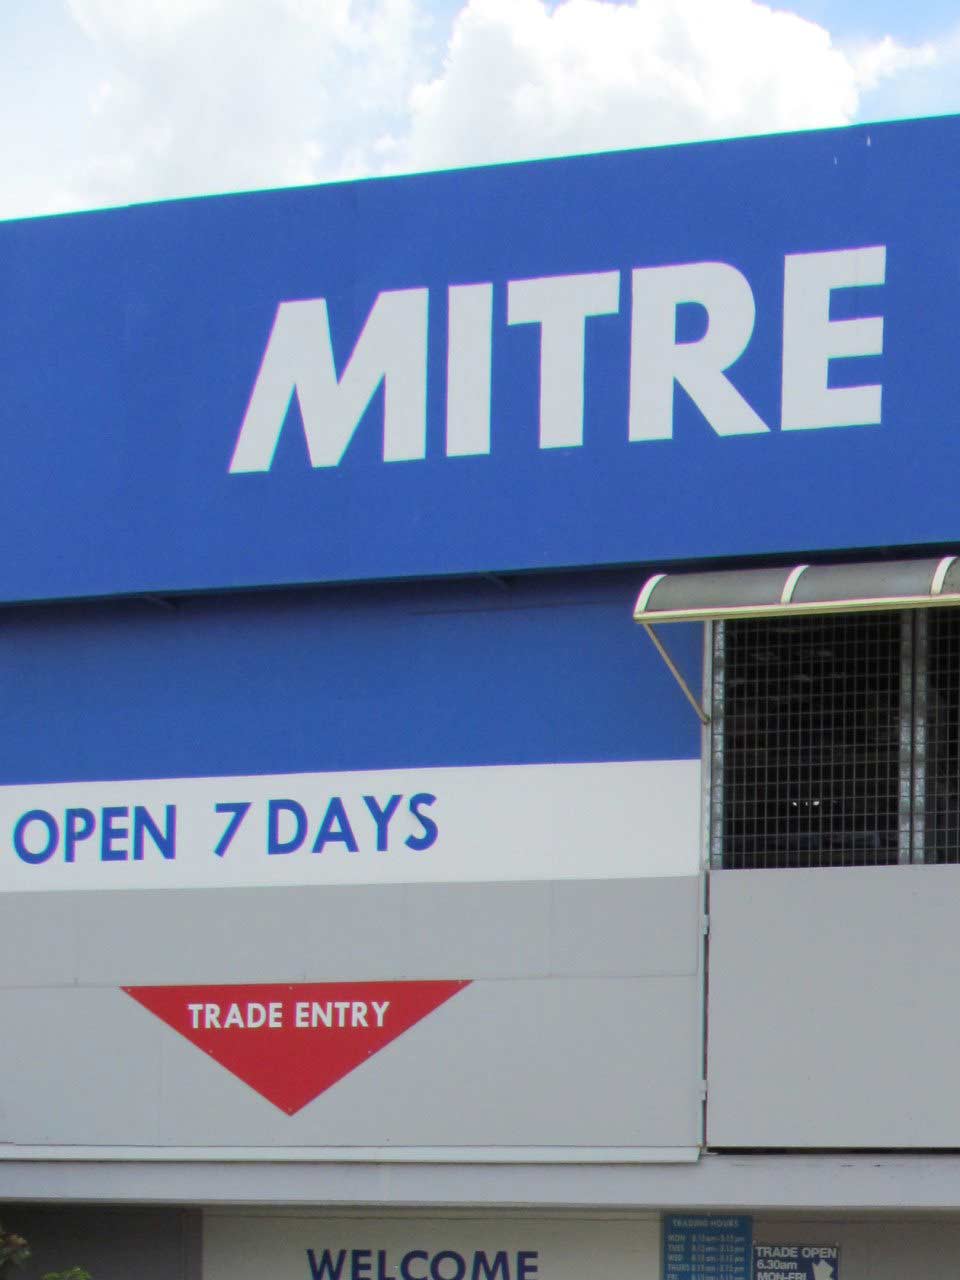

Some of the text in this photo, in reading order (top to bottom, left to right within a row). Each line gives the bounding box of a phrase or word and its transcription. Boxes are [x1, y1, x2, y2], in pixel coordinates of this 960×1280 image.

[229, 246, 886, 474] MITRE
[12, 792, 439, 866] OPEN 7 DAYS
[188, 1001, 390, 1029] TRADE ENTRY
[754, 1246, 798, 1258] TRADE
[802, 1246, 838, 1259] OPEN
[757, 1259, 798, 1271] 6.30am
